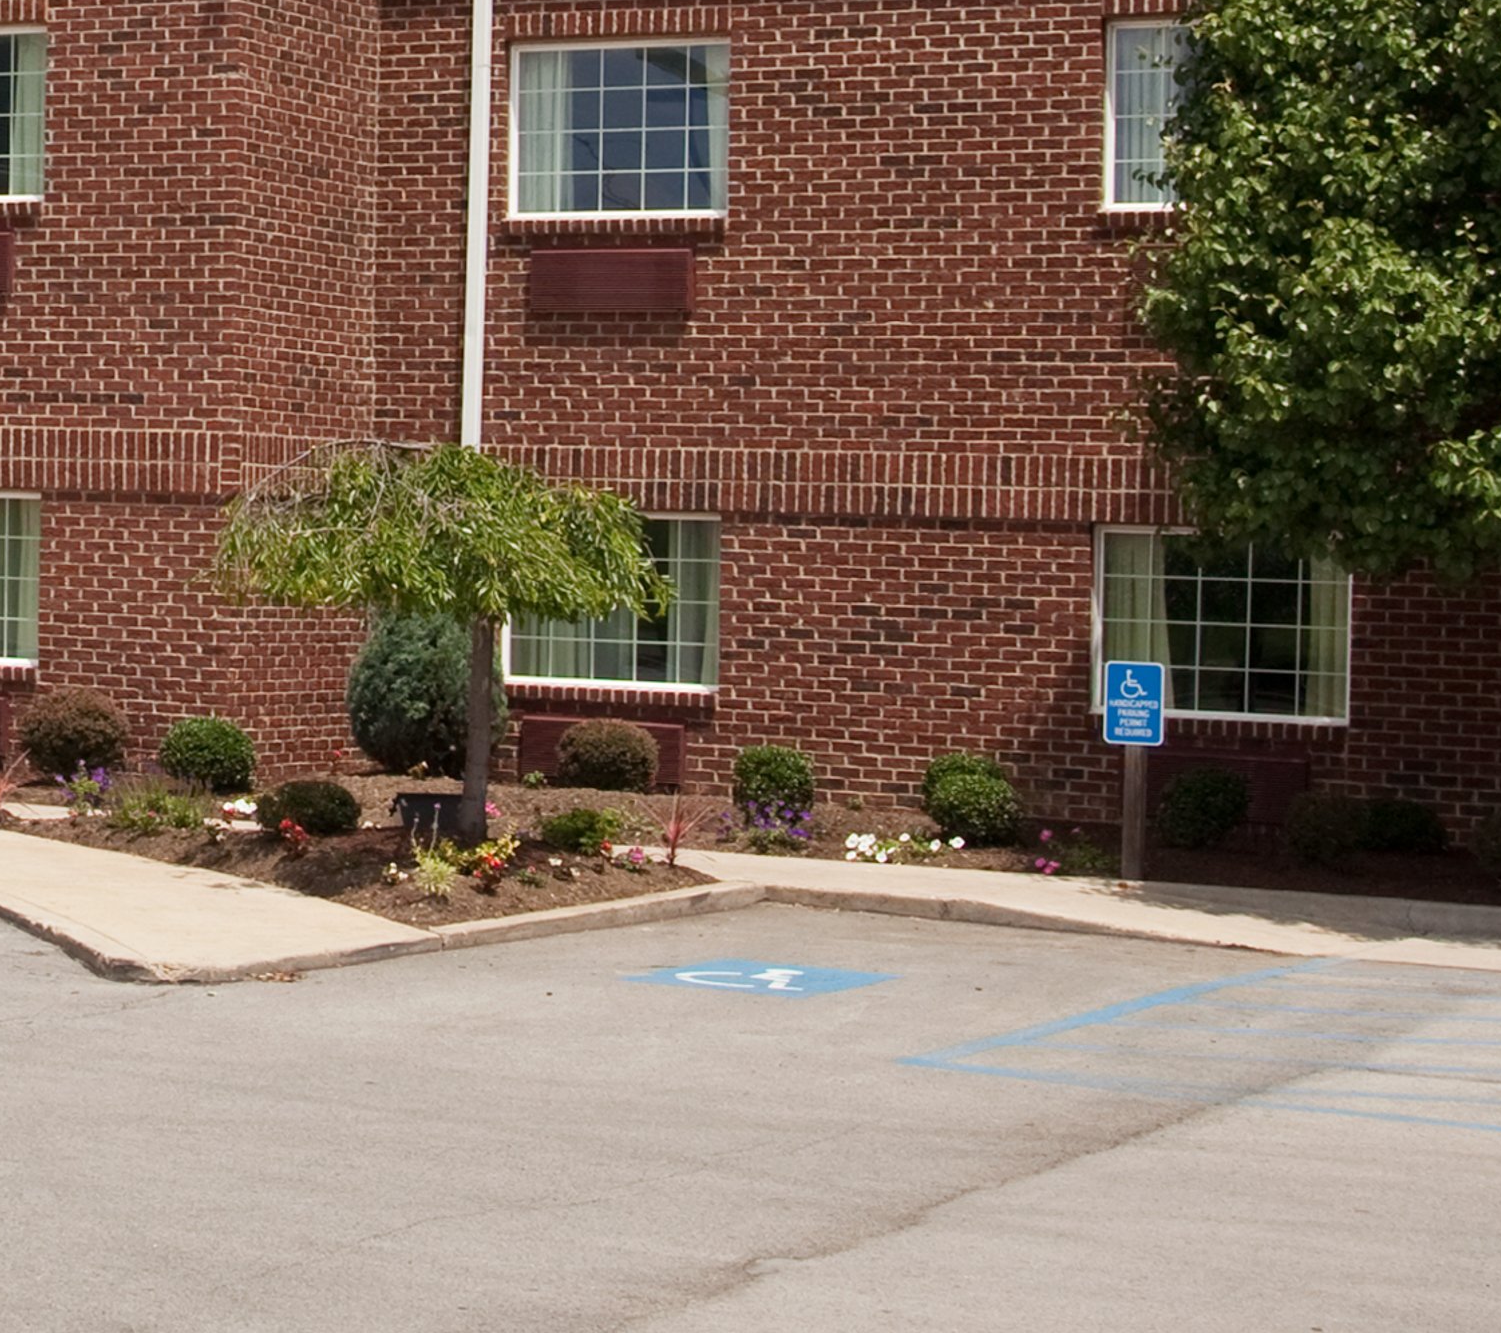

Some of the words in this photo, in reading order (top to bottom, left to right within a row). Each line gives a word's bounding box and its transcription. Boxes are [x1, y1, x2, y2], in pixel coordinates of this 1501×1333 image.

[1109, 699, 1158, 709] HANDICAPPED
[1117, 709, 1150, 718] PARKING
[1119, 718, 1148, 727] PERMIT
